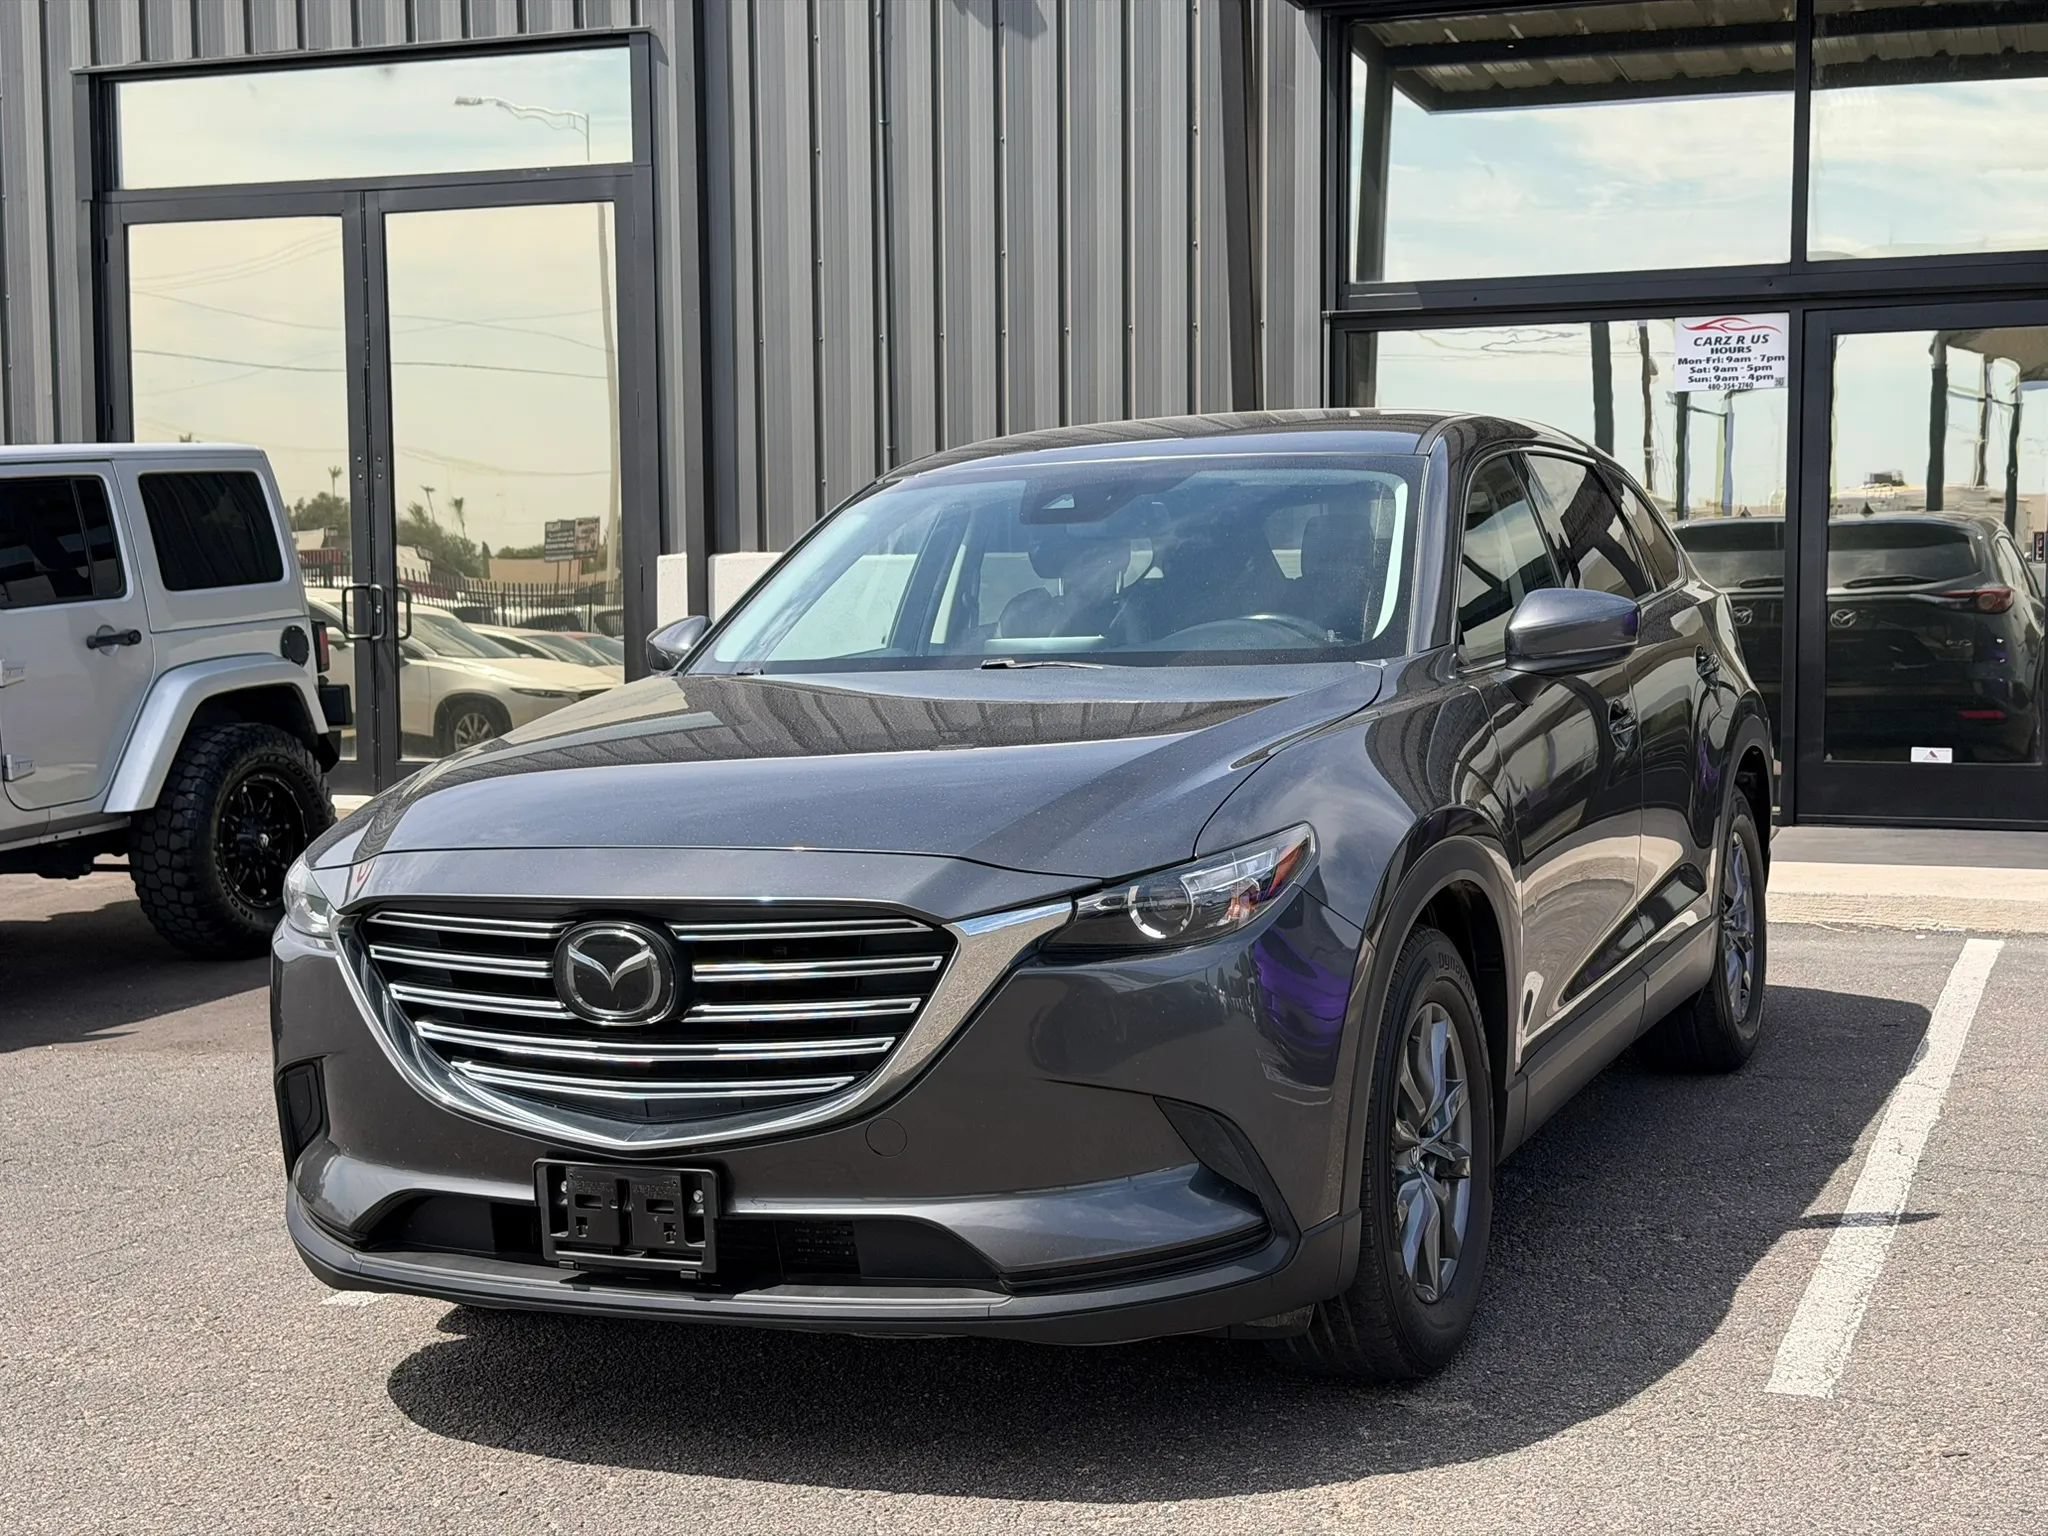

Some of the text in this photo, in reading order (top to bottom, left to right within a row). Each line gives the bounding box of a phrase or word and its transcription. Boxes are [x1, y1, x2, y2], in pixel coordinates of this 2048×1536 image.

[1693, 334, 1770, 346] CARZ R US
[1710, 346, 1752, 354] HOURS
[1677, 357, 1724, 365] Mon-Fri:
[1760, 354, 1785, 363] 7pm
[1689, 366, 1711, 374] Sat:
[1747, 364, 1772, 372] 5pm
[1748, 373, 1774, 382] 4pm
